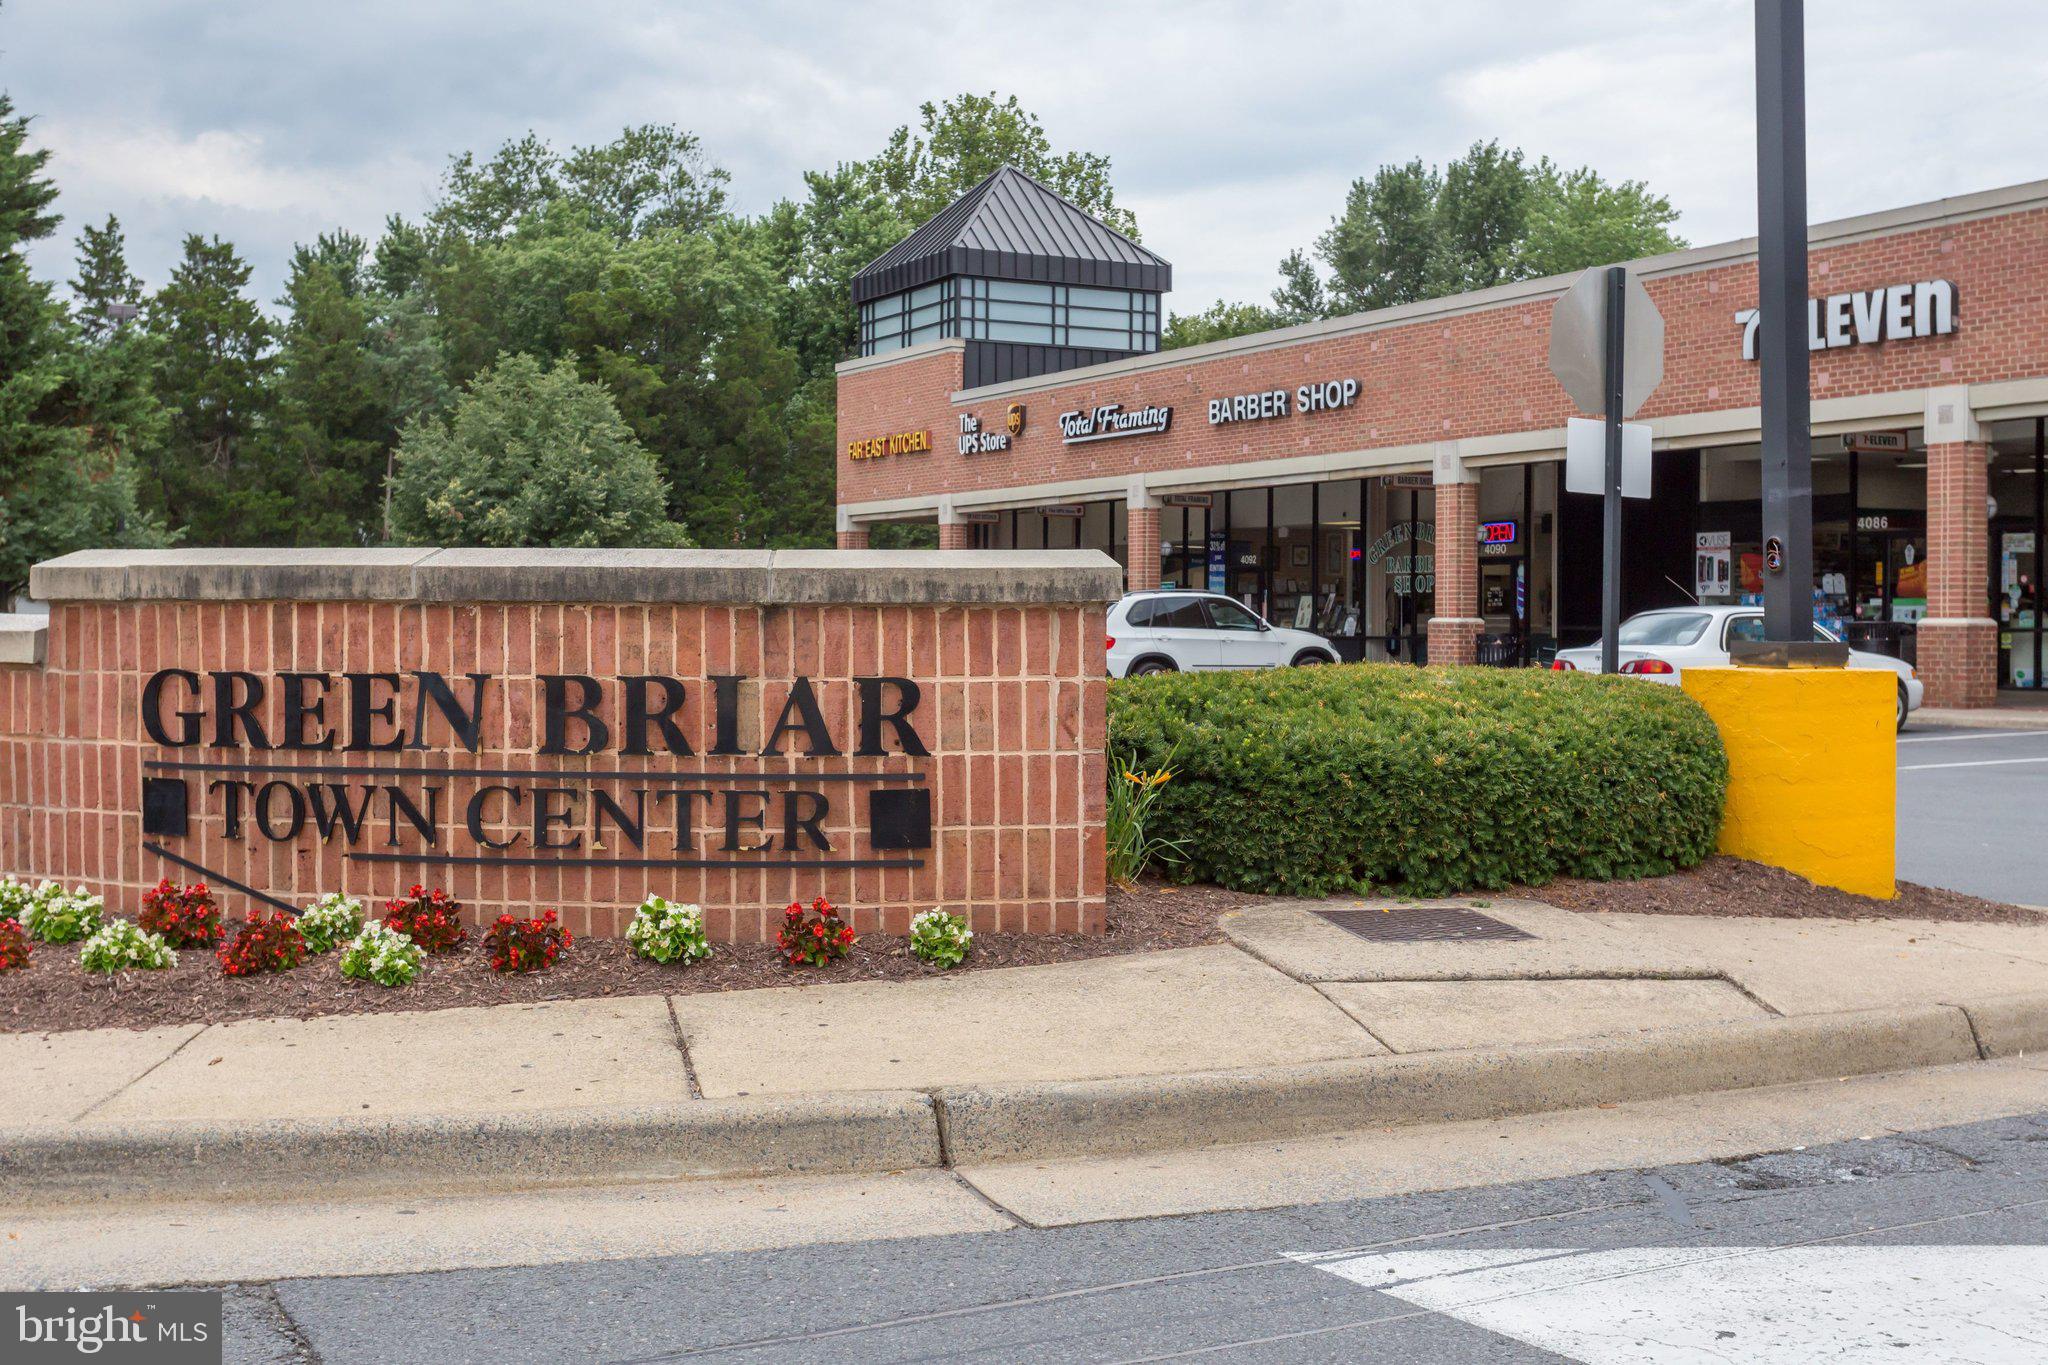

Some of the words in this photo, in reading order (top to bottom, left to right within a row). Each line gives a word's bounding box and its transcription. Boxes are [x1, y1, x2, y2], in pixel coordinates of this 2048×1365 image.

[1735, 279, 1952, 361] 7LEVEn
[1208, 390, 1287, 424] BARBER
[1296, 378, 1357, 413] SHOP
[958, 413, 978, 432] The
[1059, 407, 1097, 437] Total
[1097, 404, 1169, 432] Framing
[848, 441, 863, 460] FAR
[865, 437, 887, 458] EAST
[889, 430, 928, 454] KITCHEN
[958, 433, 979, 455] UPS
[979, 432, 1007, 452] Store
[1486, 525, 1513, 541] OPEN
[1857, 516, 1888, 529] 4086
[1240, 554, 1257, 565] 4092
[1485, 544, 1507, 554] 4090
[1386, 555, 1435, 573] BARBE
[143, 668, 492, 757] GREEN
[536, 675, 931, 758] BRIAR
[209, 779, 442, 848] TOWN
[467, 785, 838, 852] CENTER
